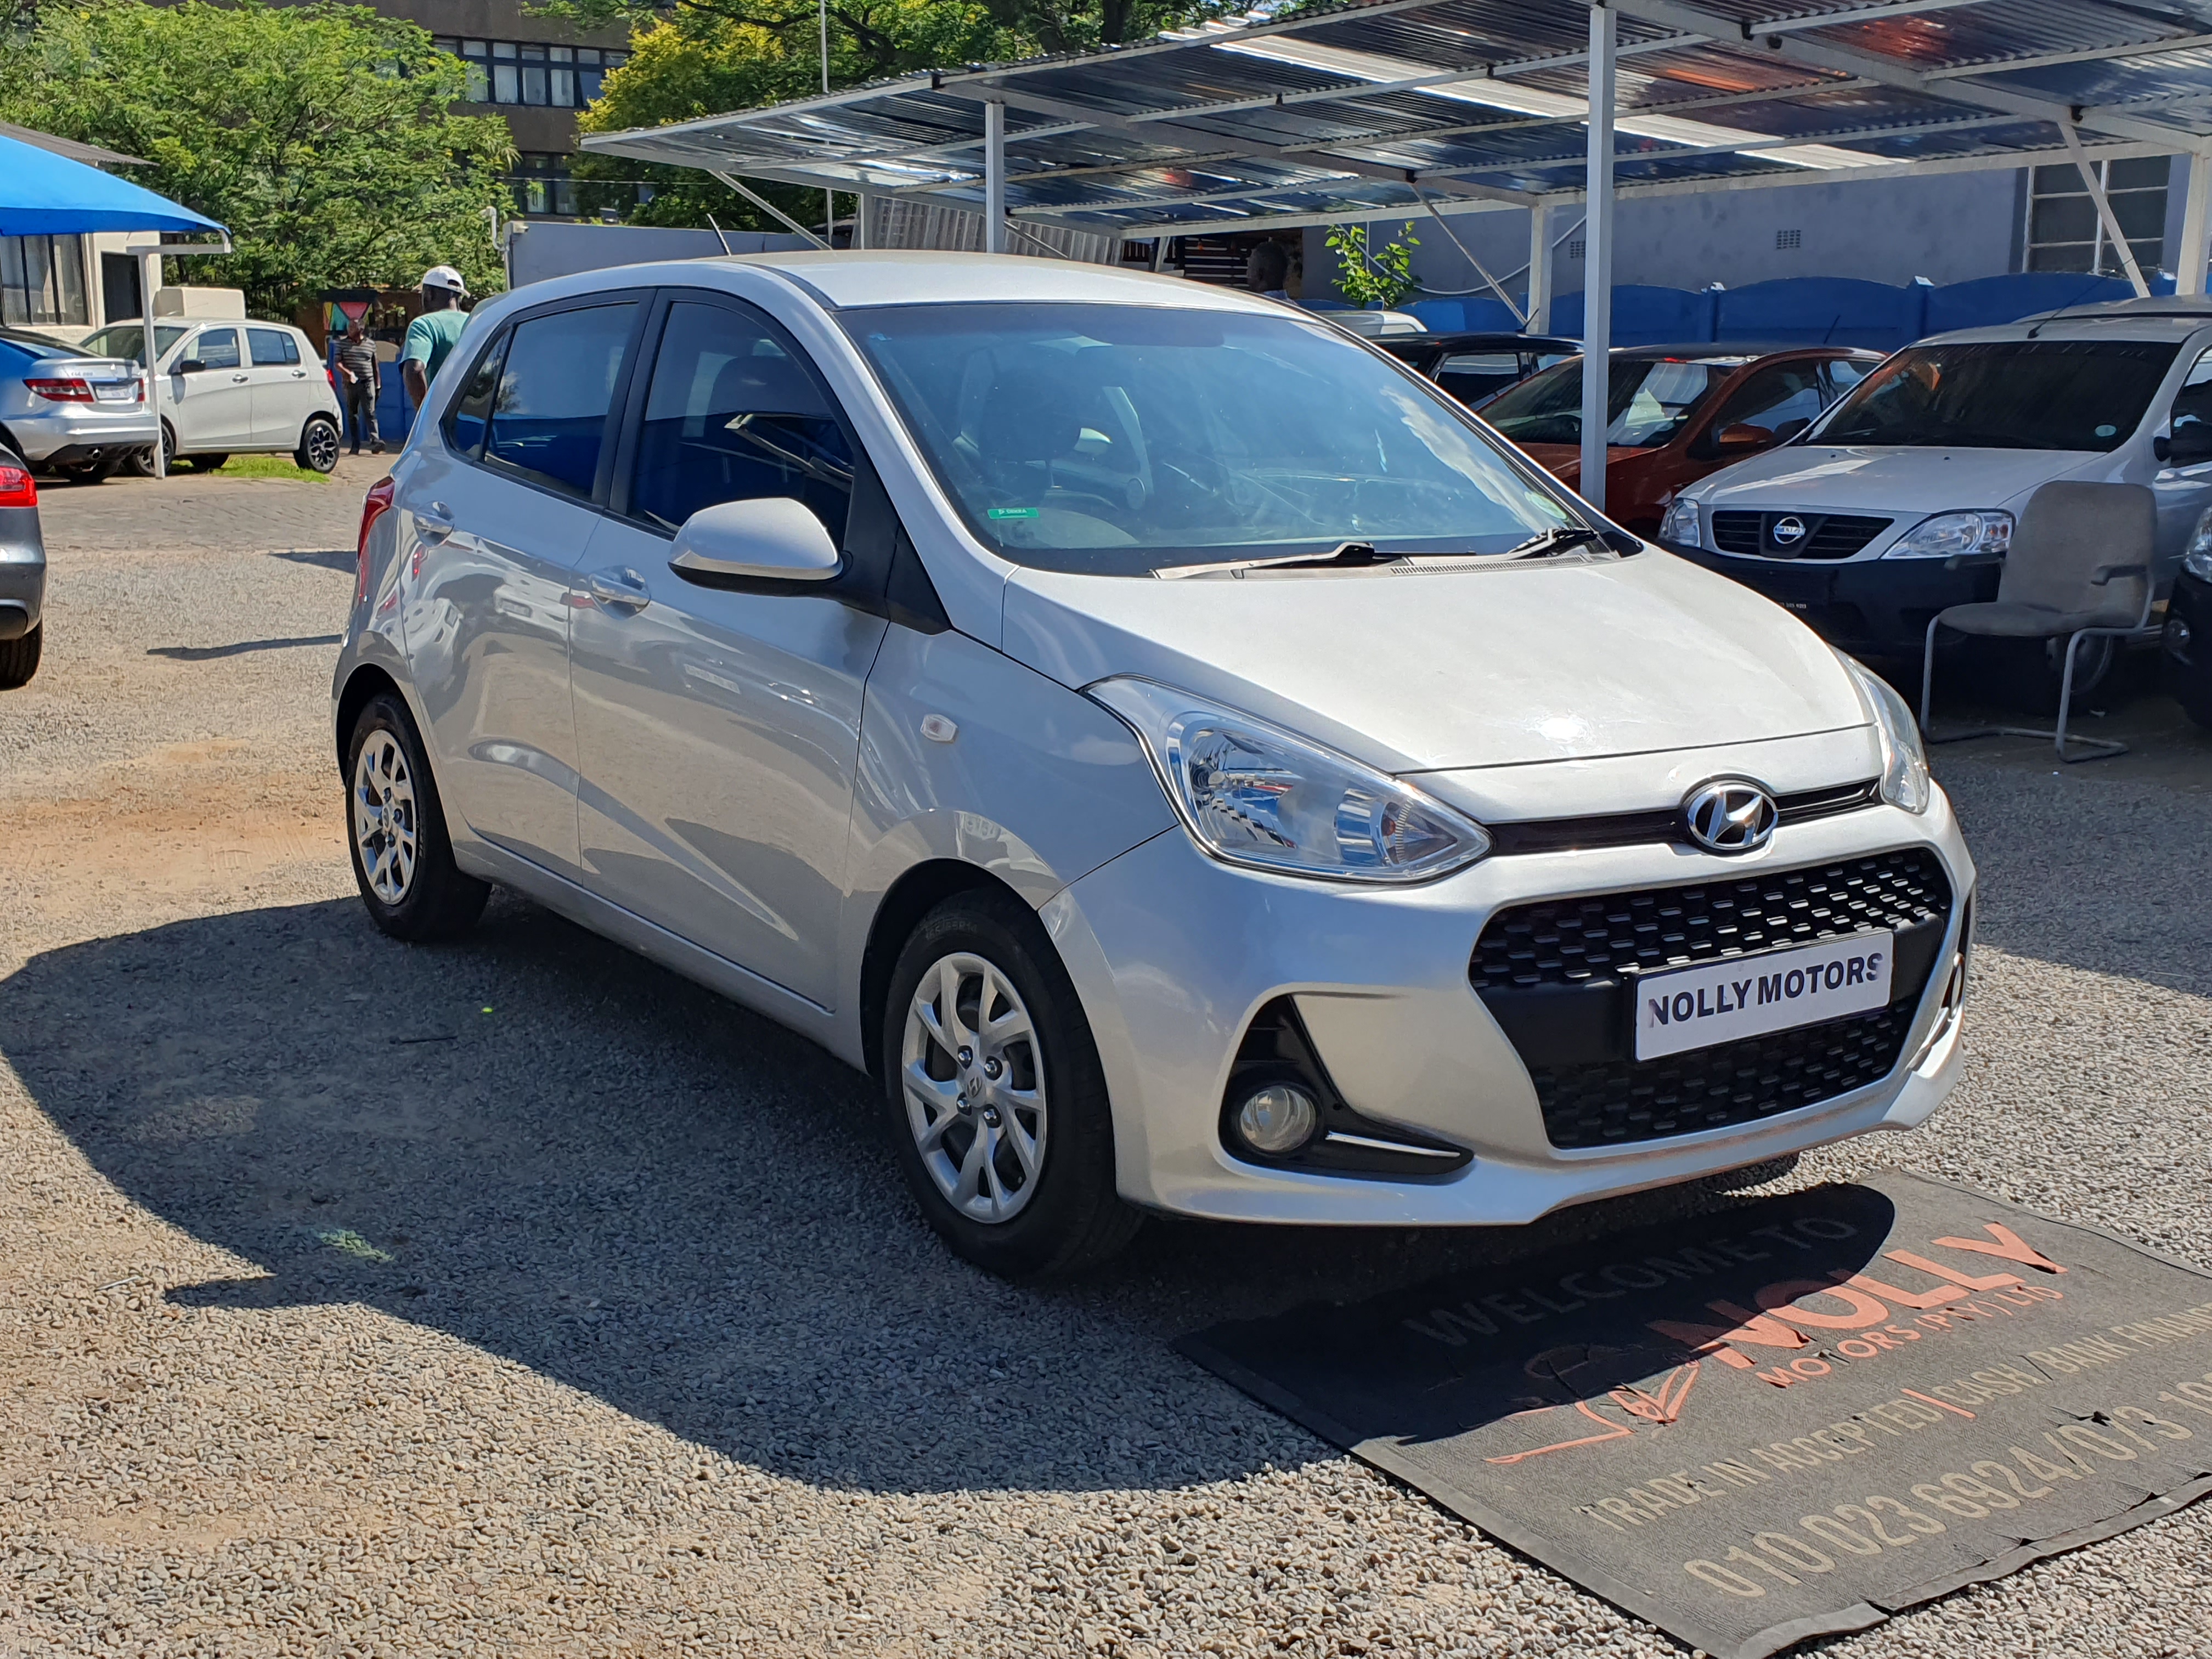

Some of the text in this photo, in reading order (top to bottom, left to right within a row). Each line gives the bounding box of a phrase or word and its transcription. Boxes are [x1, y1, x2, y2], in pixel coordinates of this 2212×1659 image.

[1647, 952, 1883, 1028] NOLLY MOTORS
[1402, 1216, 1858, 1347] WELCOME TO
[1648, 1221, 2068, 1369] NOLLY
[1994, 1285, 2063, 1307] LTD
[1571, 1469, 1728, 1532] TRADE
[1701, 1457, 1771, 1487] IN
[1749, 1398, 1945, 1474] ACCEPTED
[1683, 1532, 1836, 1598] 010
[1799, 1495, 1948, 1556] 023
